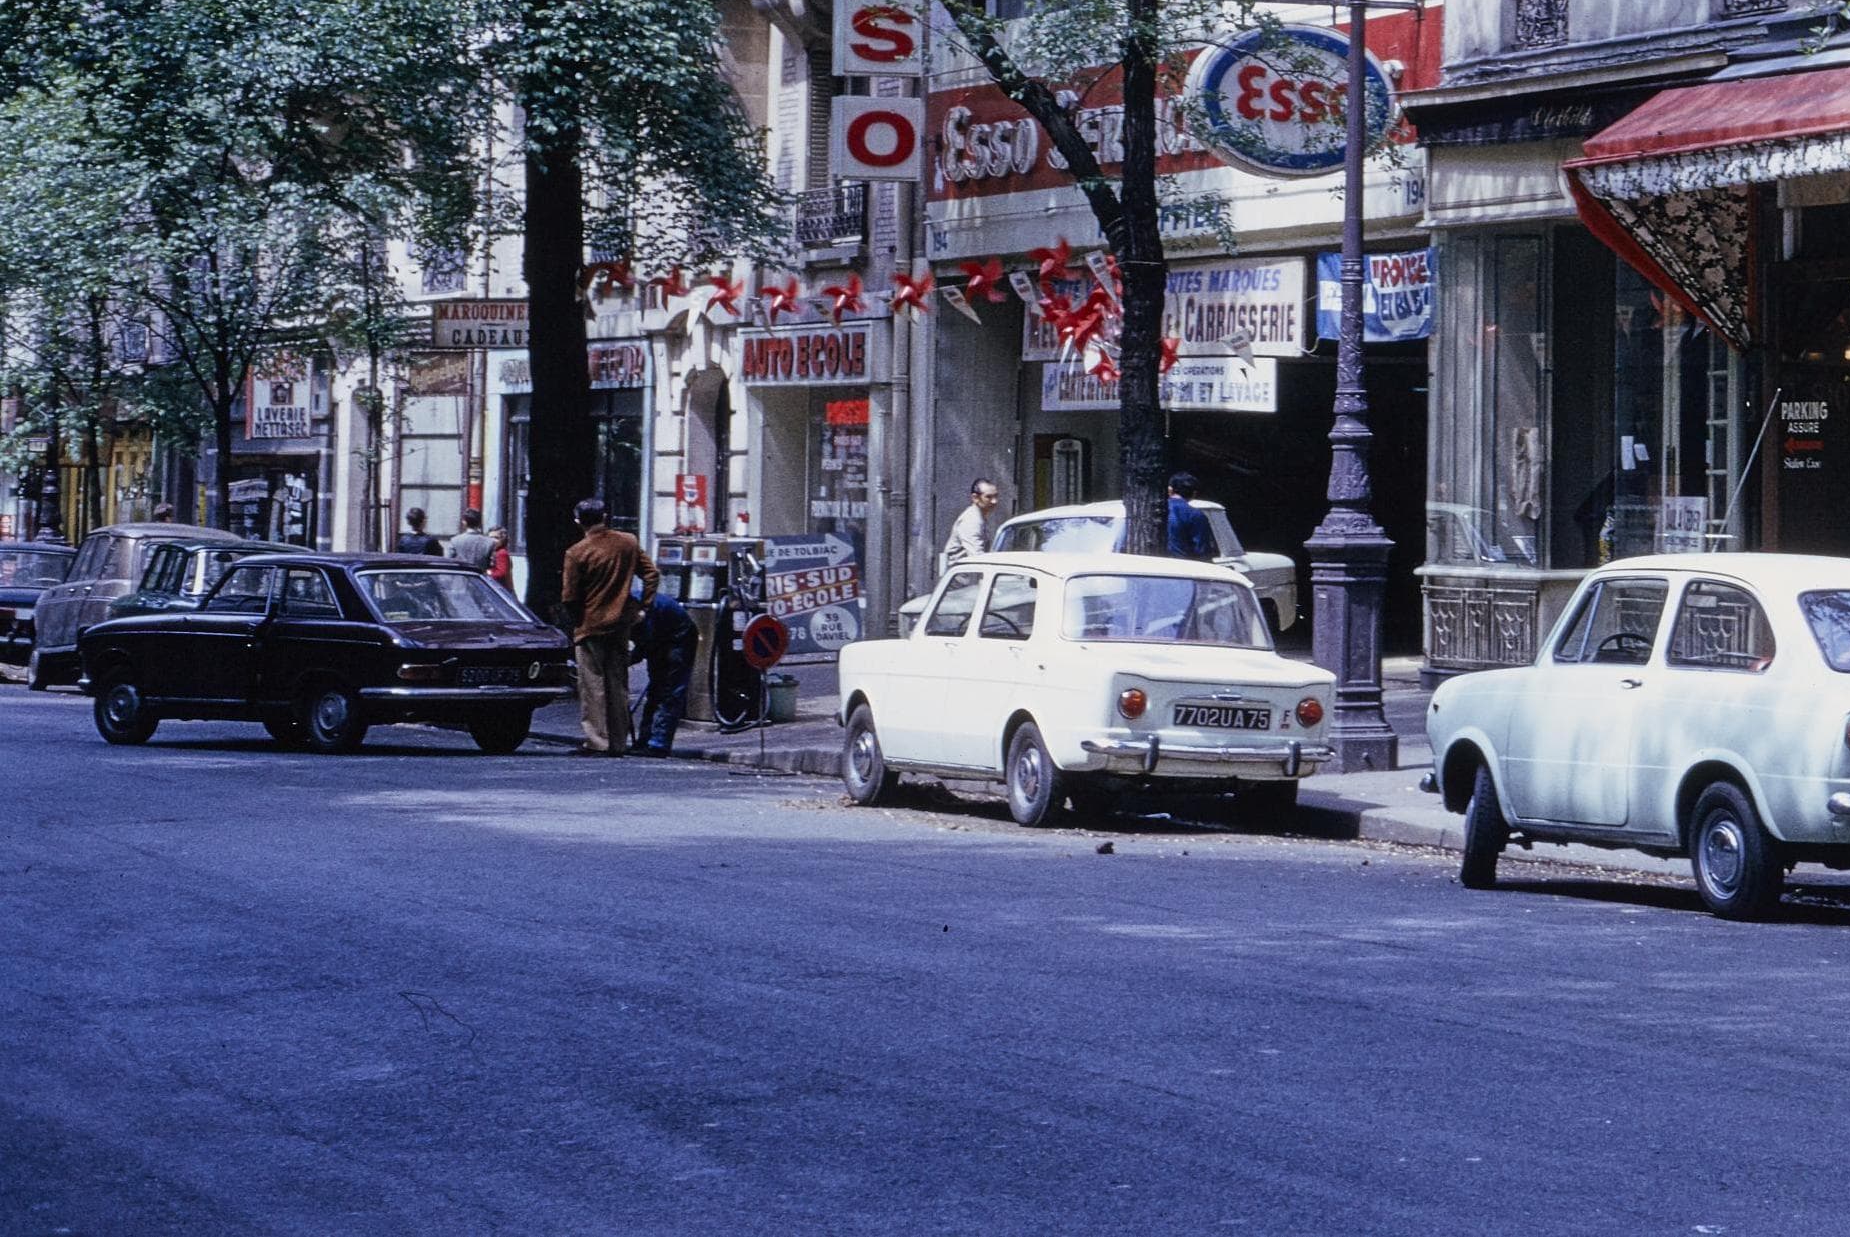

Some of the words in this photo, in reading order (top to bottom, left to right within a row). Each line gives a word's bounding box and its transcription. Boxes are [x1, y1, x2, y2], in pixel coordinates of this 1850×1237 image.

[1406, 180, 1425, 205] 194
[933, 232, 948, 252] 194
[1208, 268, 1281, 295] MARQUES
[437, 303, 530, 320] MAROQUINE
[1184, 296, 1295, 343] CARROSSERIE
[451, 329, 530, 345] CADEAU
[743, 336, 793, 379] AUTO
[797, 332, 865, 376] ECOLE
[1781, 401, 1828, 420] PARKING
[794, 545, 838, 556] TOLBIAC
[822, 623, 843, 631] RUE
